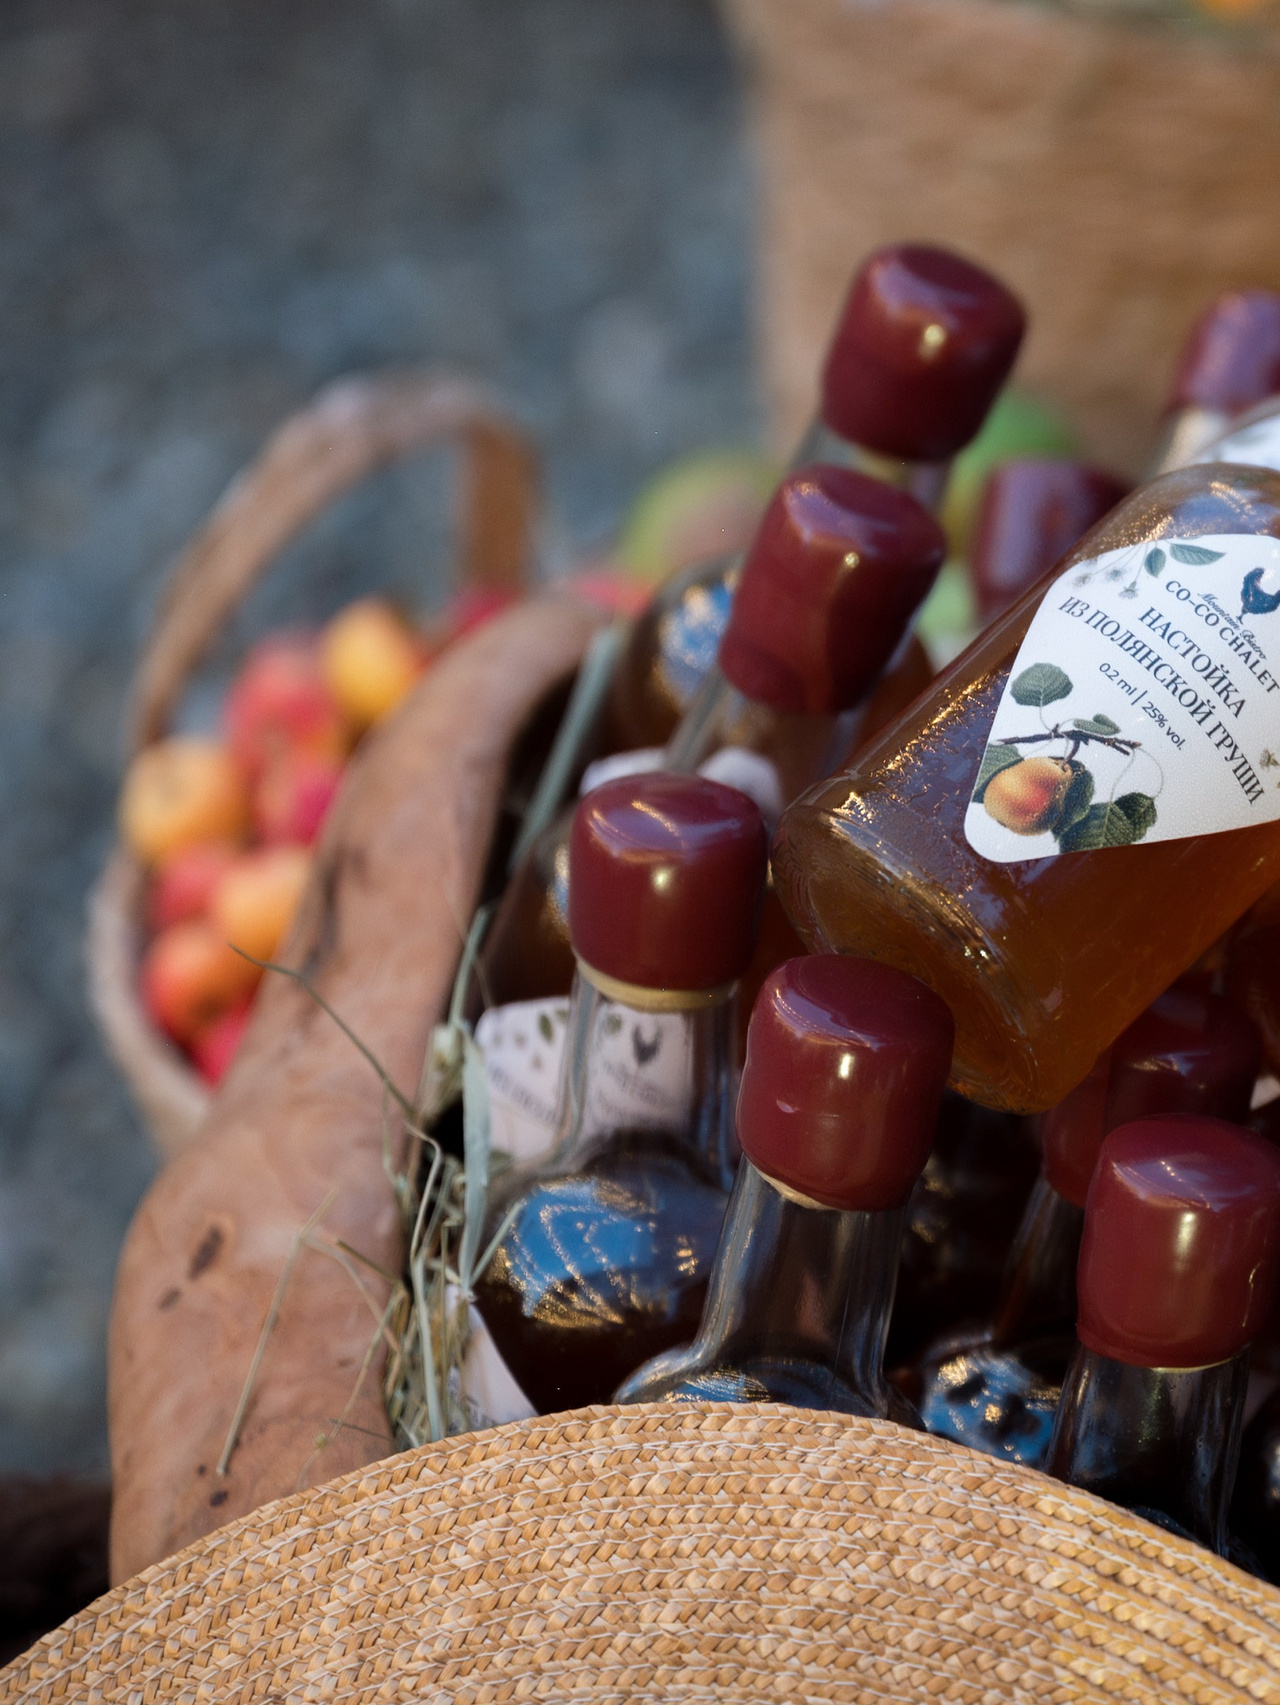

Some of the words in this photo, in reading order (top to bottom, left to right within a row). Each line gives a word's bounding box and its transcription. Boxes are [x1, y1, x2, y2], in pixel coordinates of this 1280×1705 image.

[1137, 606, 1247, 719] НАСТОЙКА
[1165, 580, 1220, 627] CO-CO
[1219, 626, 1280, 693] CHALET
[1197, 592, 1240, 630] Mountain
[1240, 629, 1267, 660] Bistro
[1057, 596, 1087, 619] ИЗ
[1084, 609, 1213, 727] ПОЛЯНСКОЙ
[1205, 720, 1265, 805] ГРУШИ
[1116, 678, 1137, 696] ml
[1142, 700, 1168, 728] 25%
[1165, 726, 1187, 751] vol.
